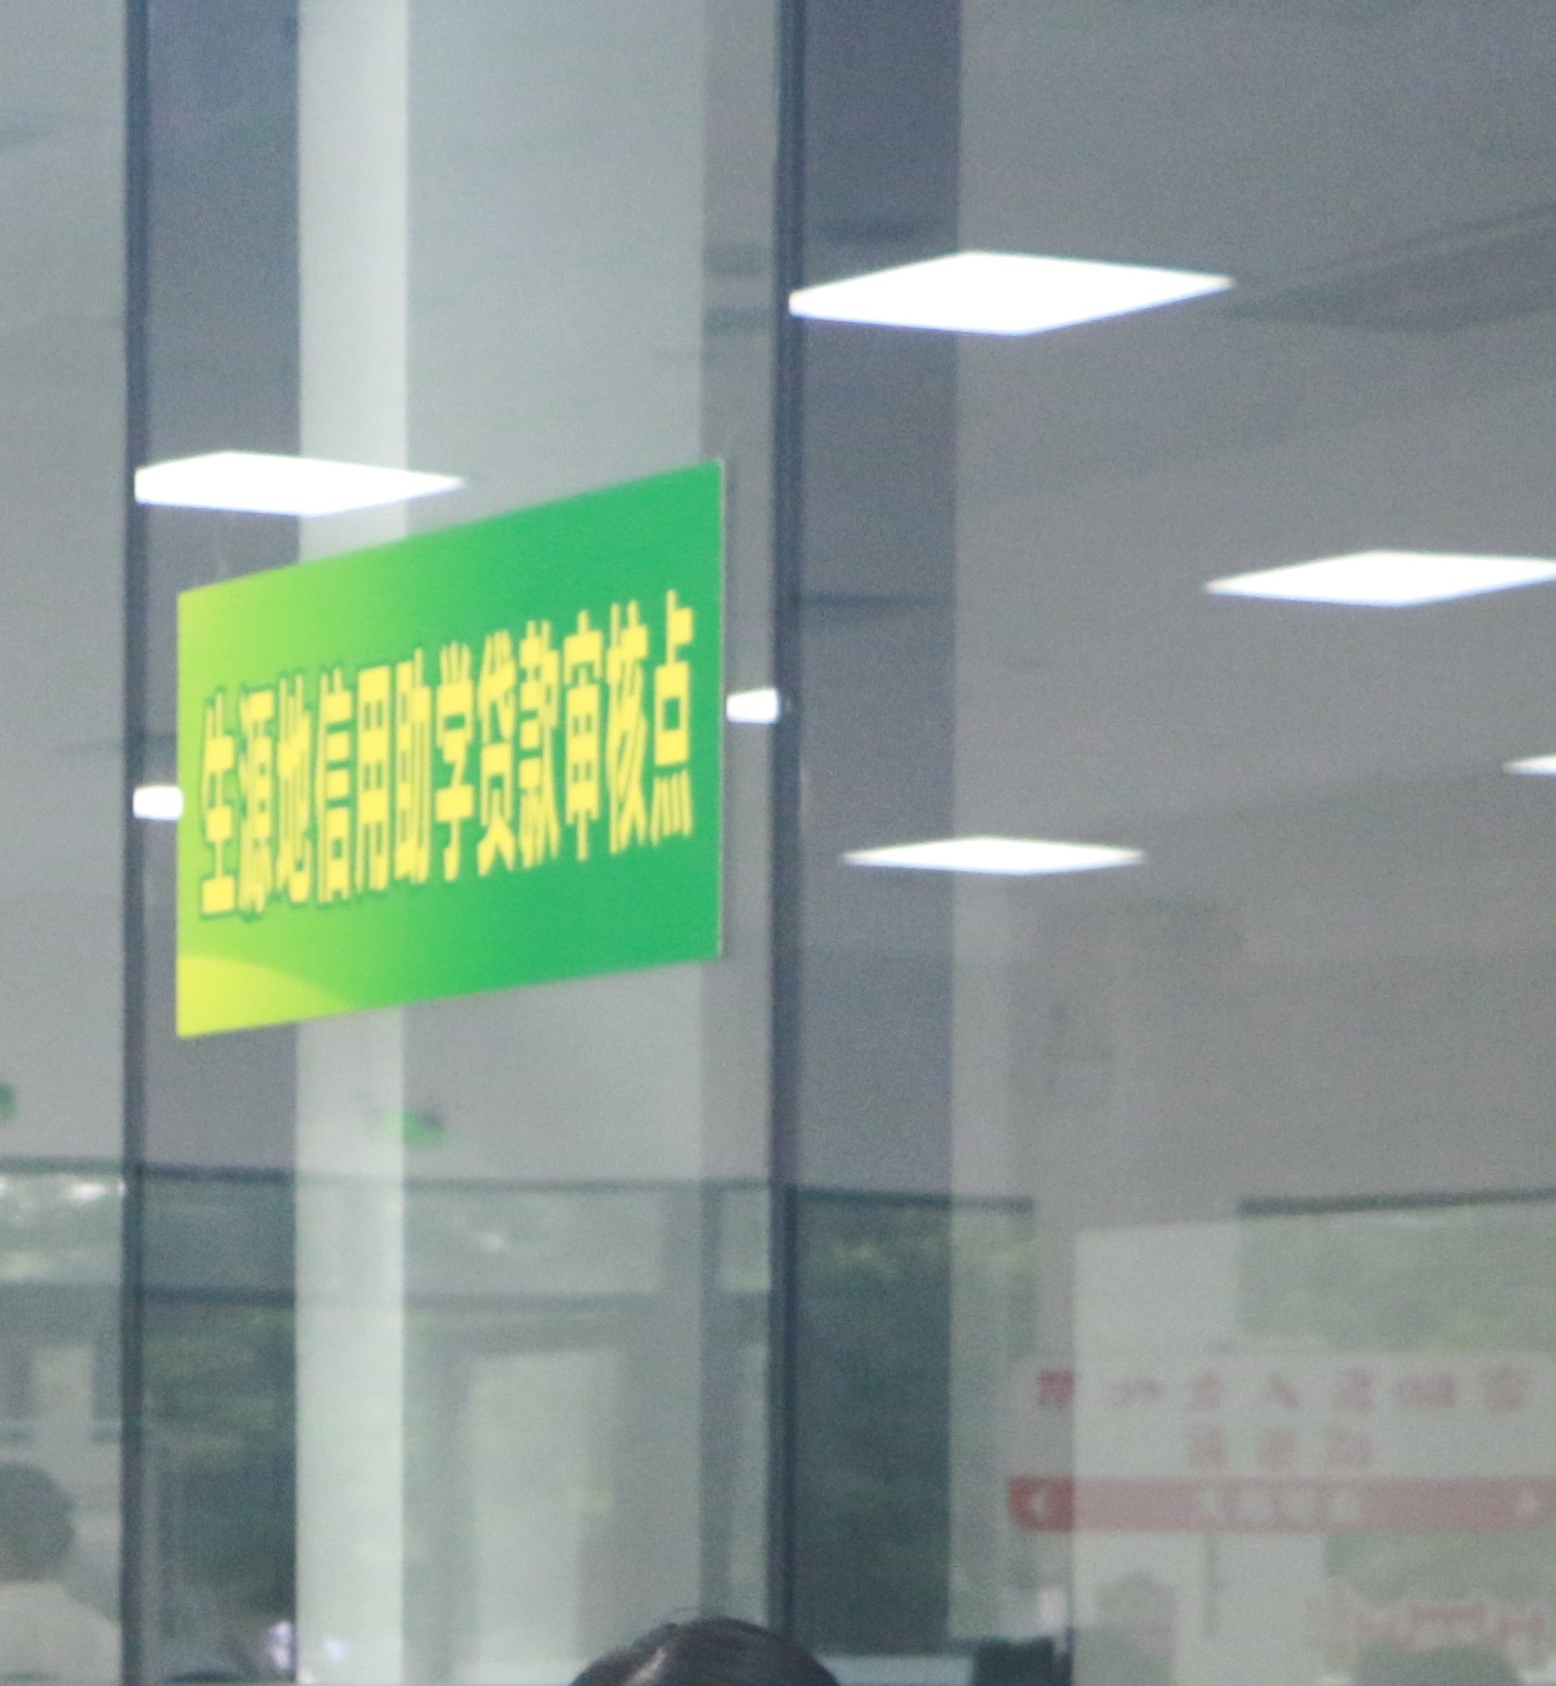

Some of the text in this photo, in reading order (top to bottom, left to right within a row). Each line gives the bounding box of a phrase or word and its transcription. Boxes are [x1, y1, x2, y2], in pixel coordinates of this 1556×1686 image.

[200, 588, 693, 917] 生源地信用助学贷款审核点
